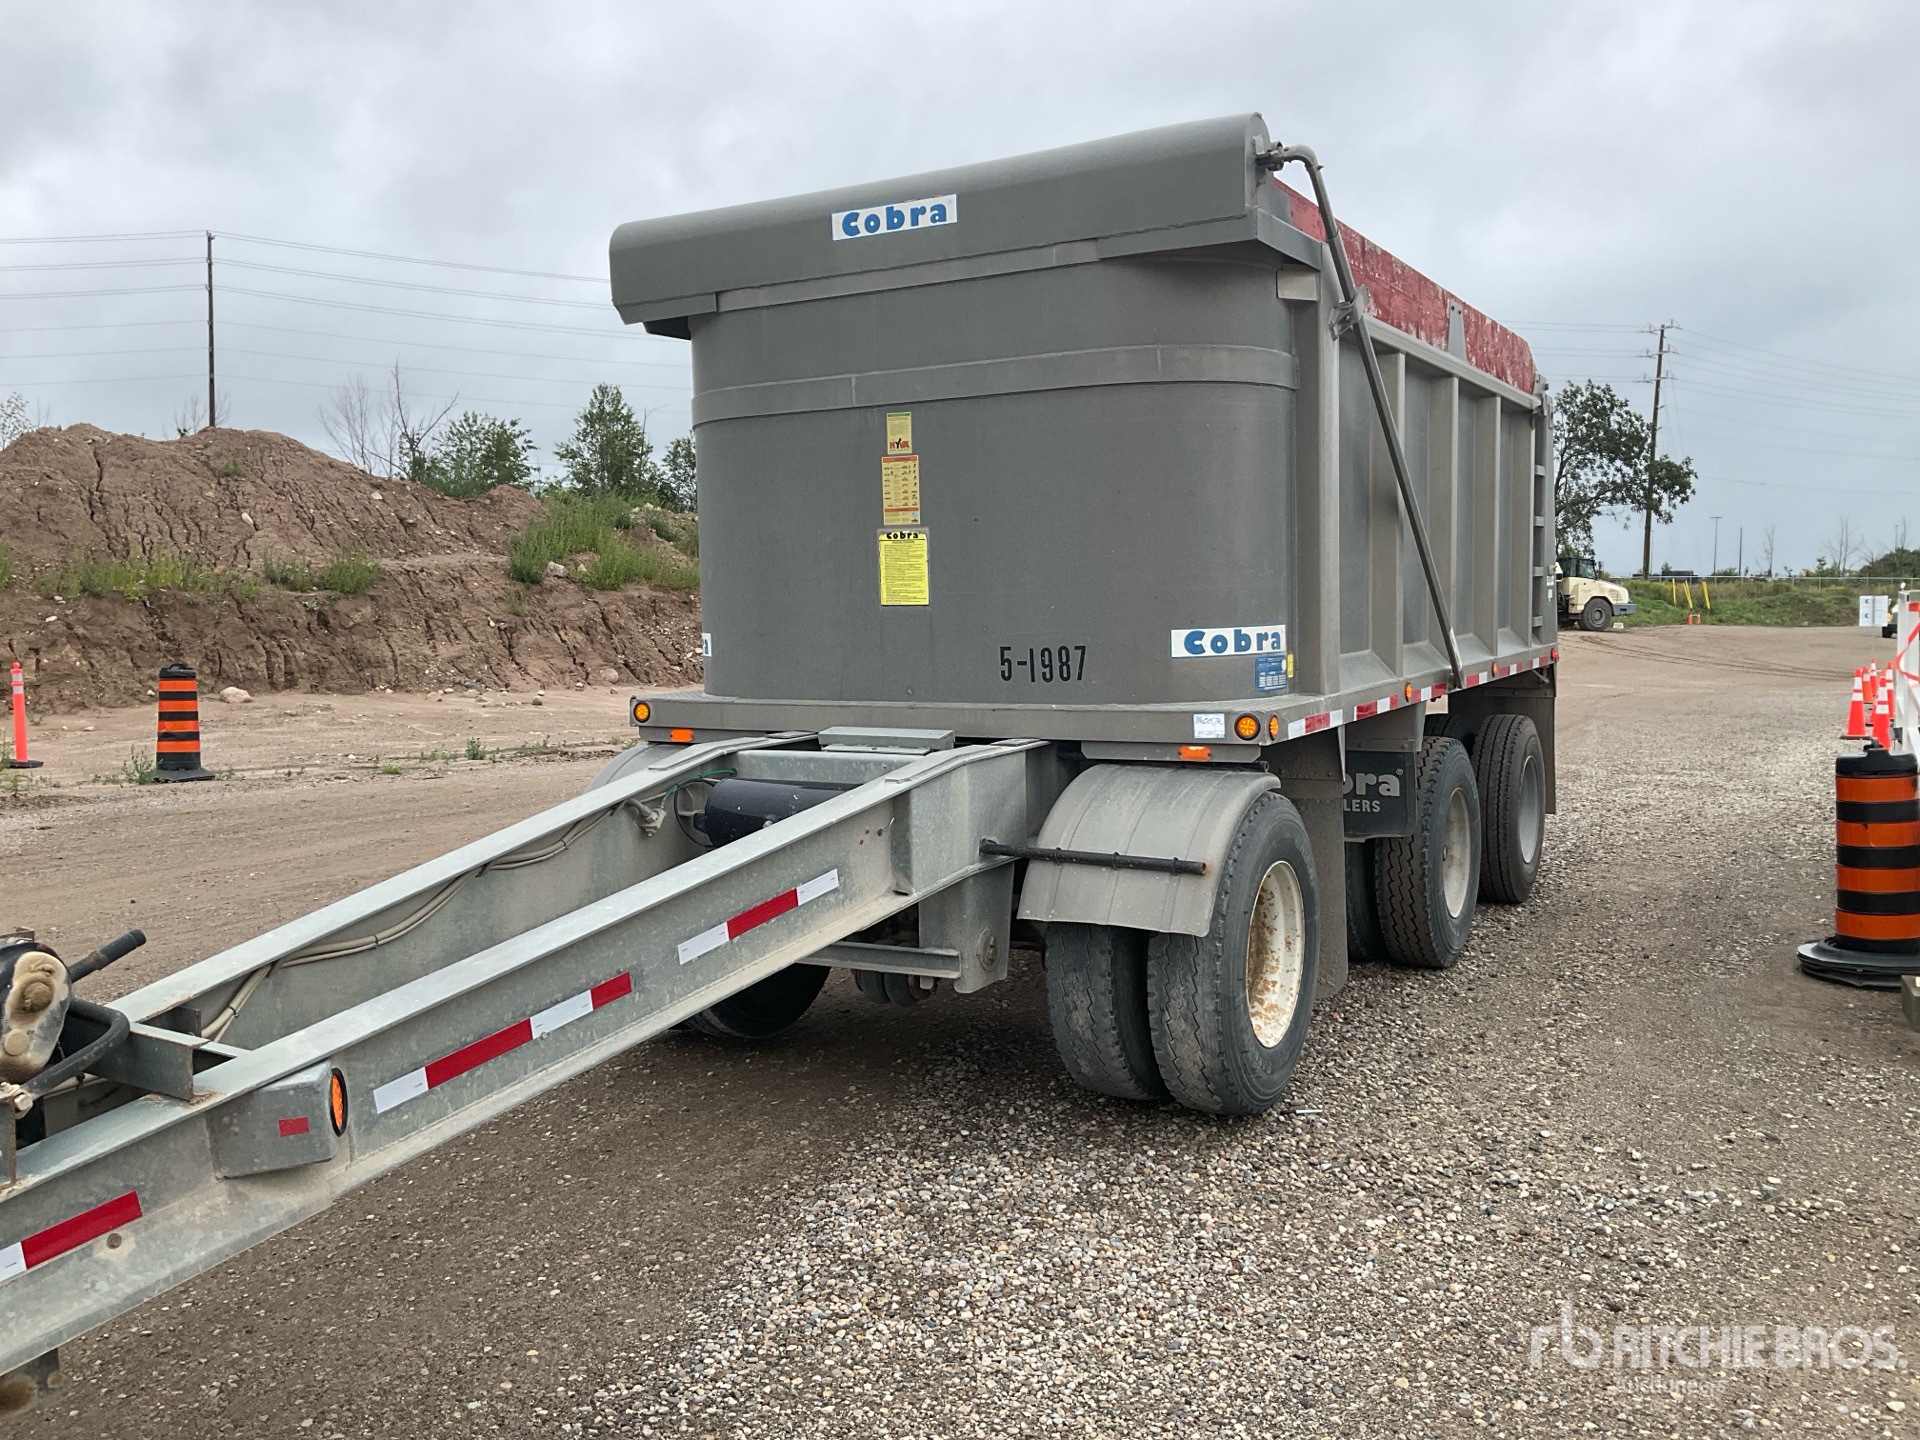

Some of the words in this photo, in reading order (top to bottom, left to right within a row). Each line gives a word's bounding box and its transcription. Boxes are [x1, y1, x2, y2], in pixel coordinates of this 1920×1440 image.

[841, 203, 947, 237] Cobra
[1183, 628, 1281, 655] Cobra
[1000, 645, 1086, 683] 5-1987
